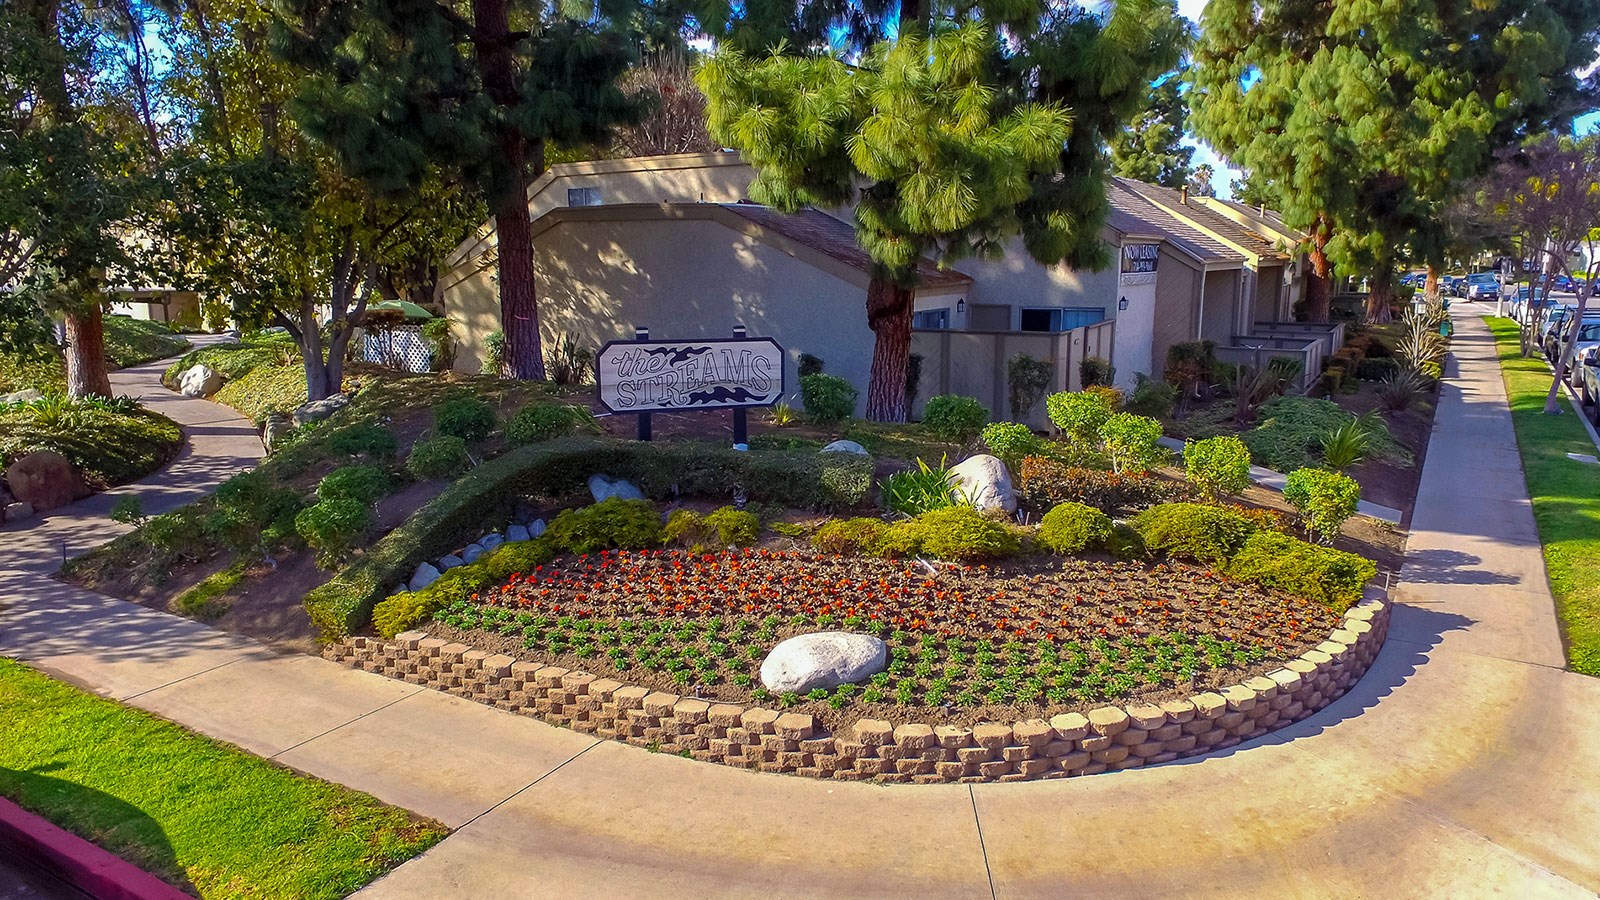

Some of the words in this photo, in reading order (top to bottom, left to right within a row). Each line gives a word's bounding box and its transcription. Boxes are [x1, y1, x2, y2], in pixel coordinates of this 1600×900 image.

[1124, 244, 1140, 259] NOW
[611, 348, 674, 377] the
[616, 349, 772, 407] STREAMS
